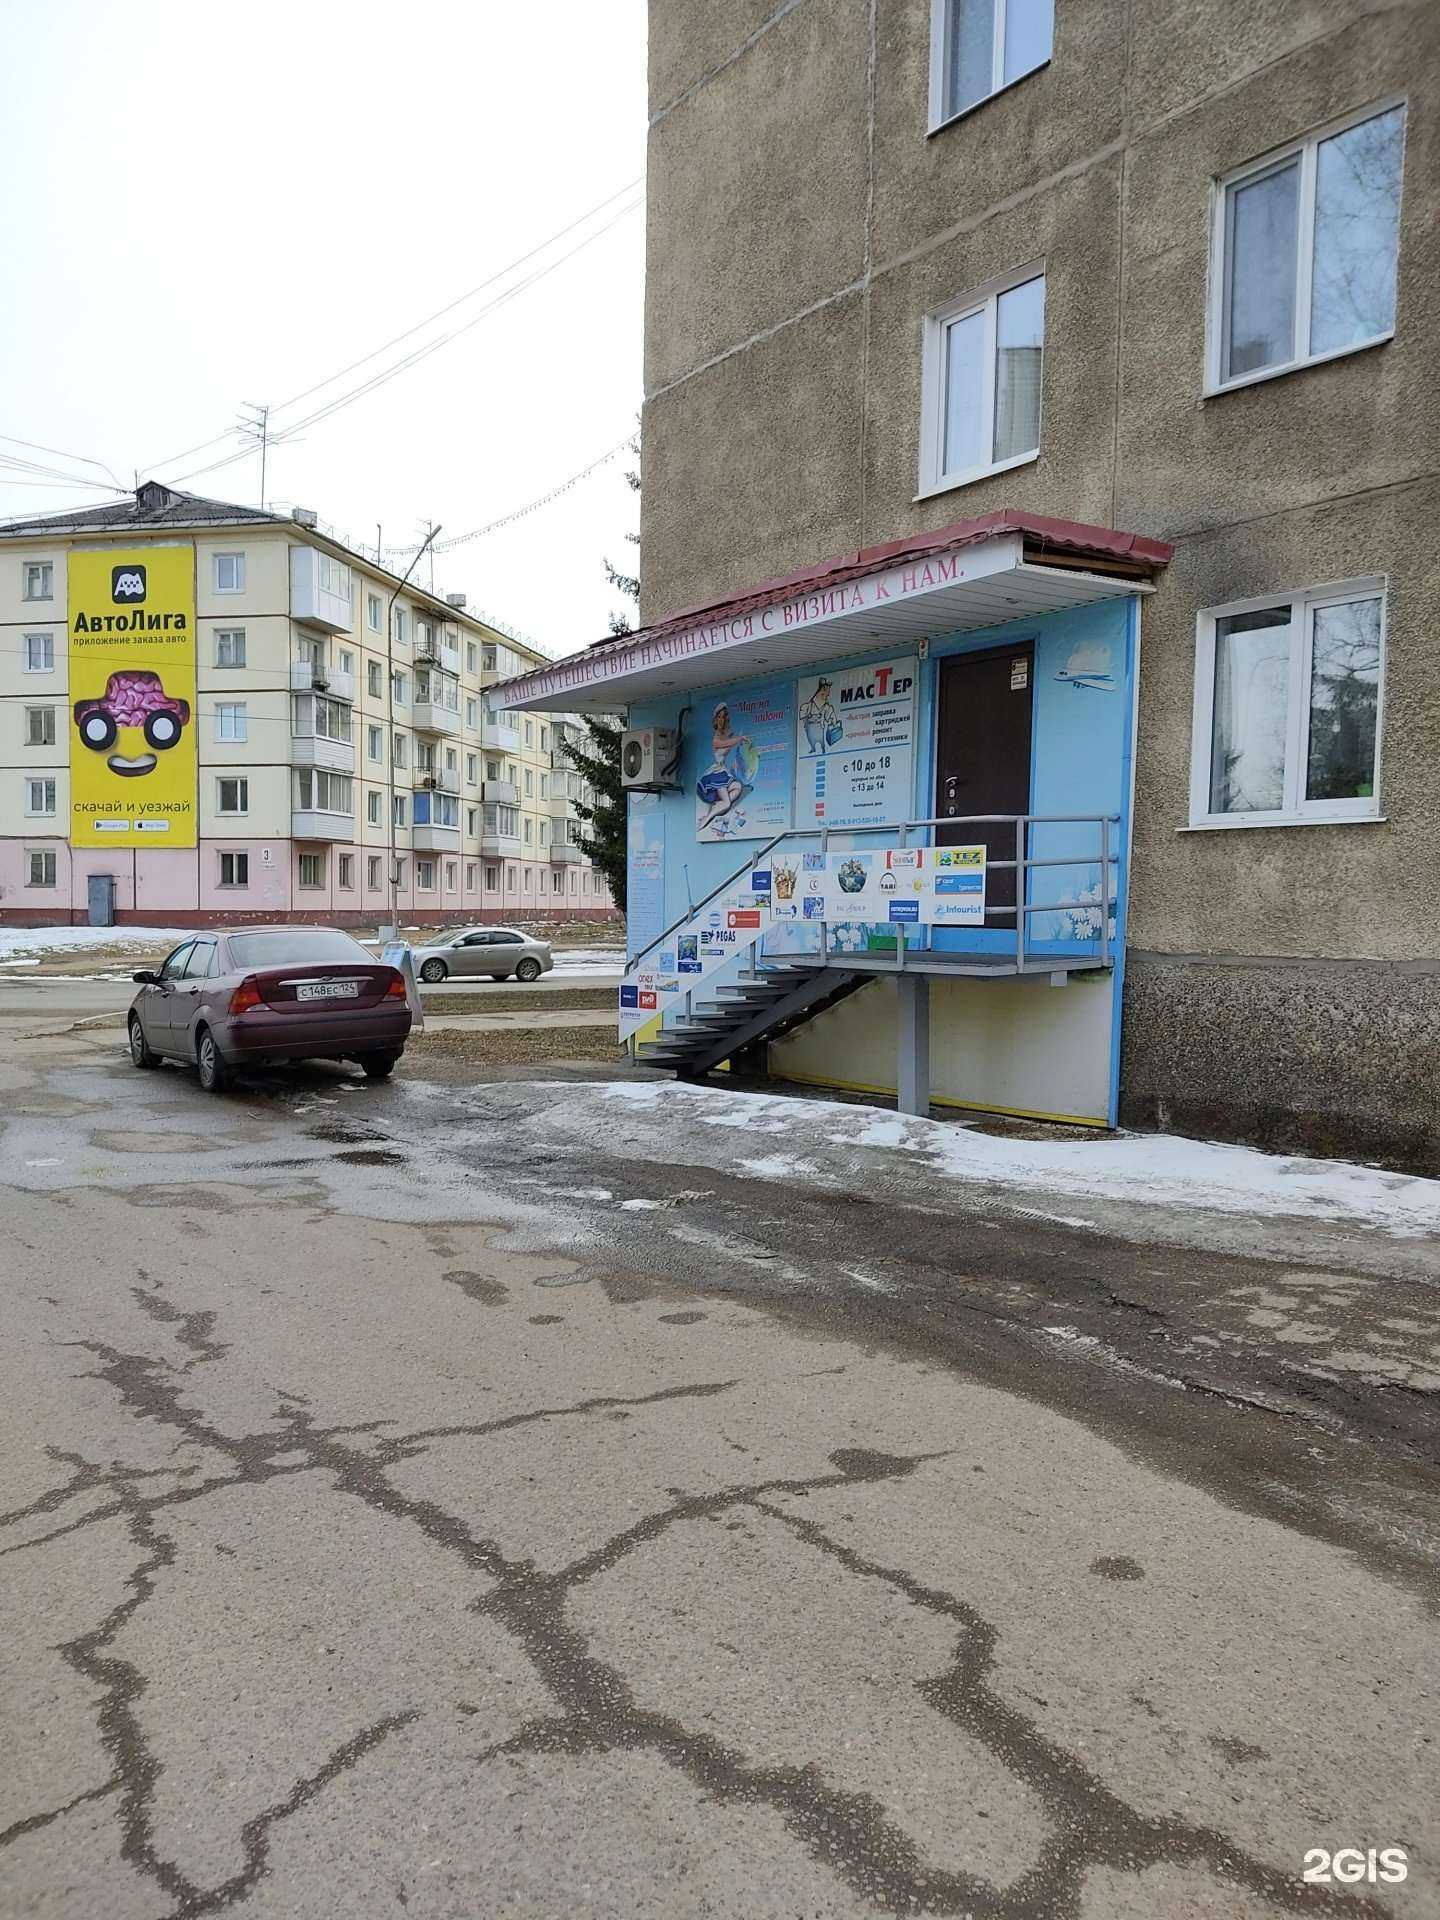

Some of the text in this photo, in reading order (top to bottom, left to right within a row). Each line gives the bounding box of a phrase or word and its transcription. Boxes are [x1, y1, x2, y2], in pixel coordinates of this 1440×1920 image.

[74, 609, 186, 633] АвтоЛига
[504, 554, 966, 704] ВАШЕ ПУТЕШЕСТВИЕ НАЧИНАЕТСЯ С ВИЗИТА К НАМ.
[73, 635, 186, 647] приложение заказа авто
[840, 667, 913, 704] МАСТЕР
[843, 756, 891, 773] с 10 до 18
[857, 782, 866, 792] 13
[866, 784, 874, 792] до
[876, 781, 884, 790] 14
[73, 800, 190, 815] скачай и уезжай
[263, 850, 269, 861] 3
[946, 904, 982, 914] Intourist
[716, 930, 736, 942] PEGAS
